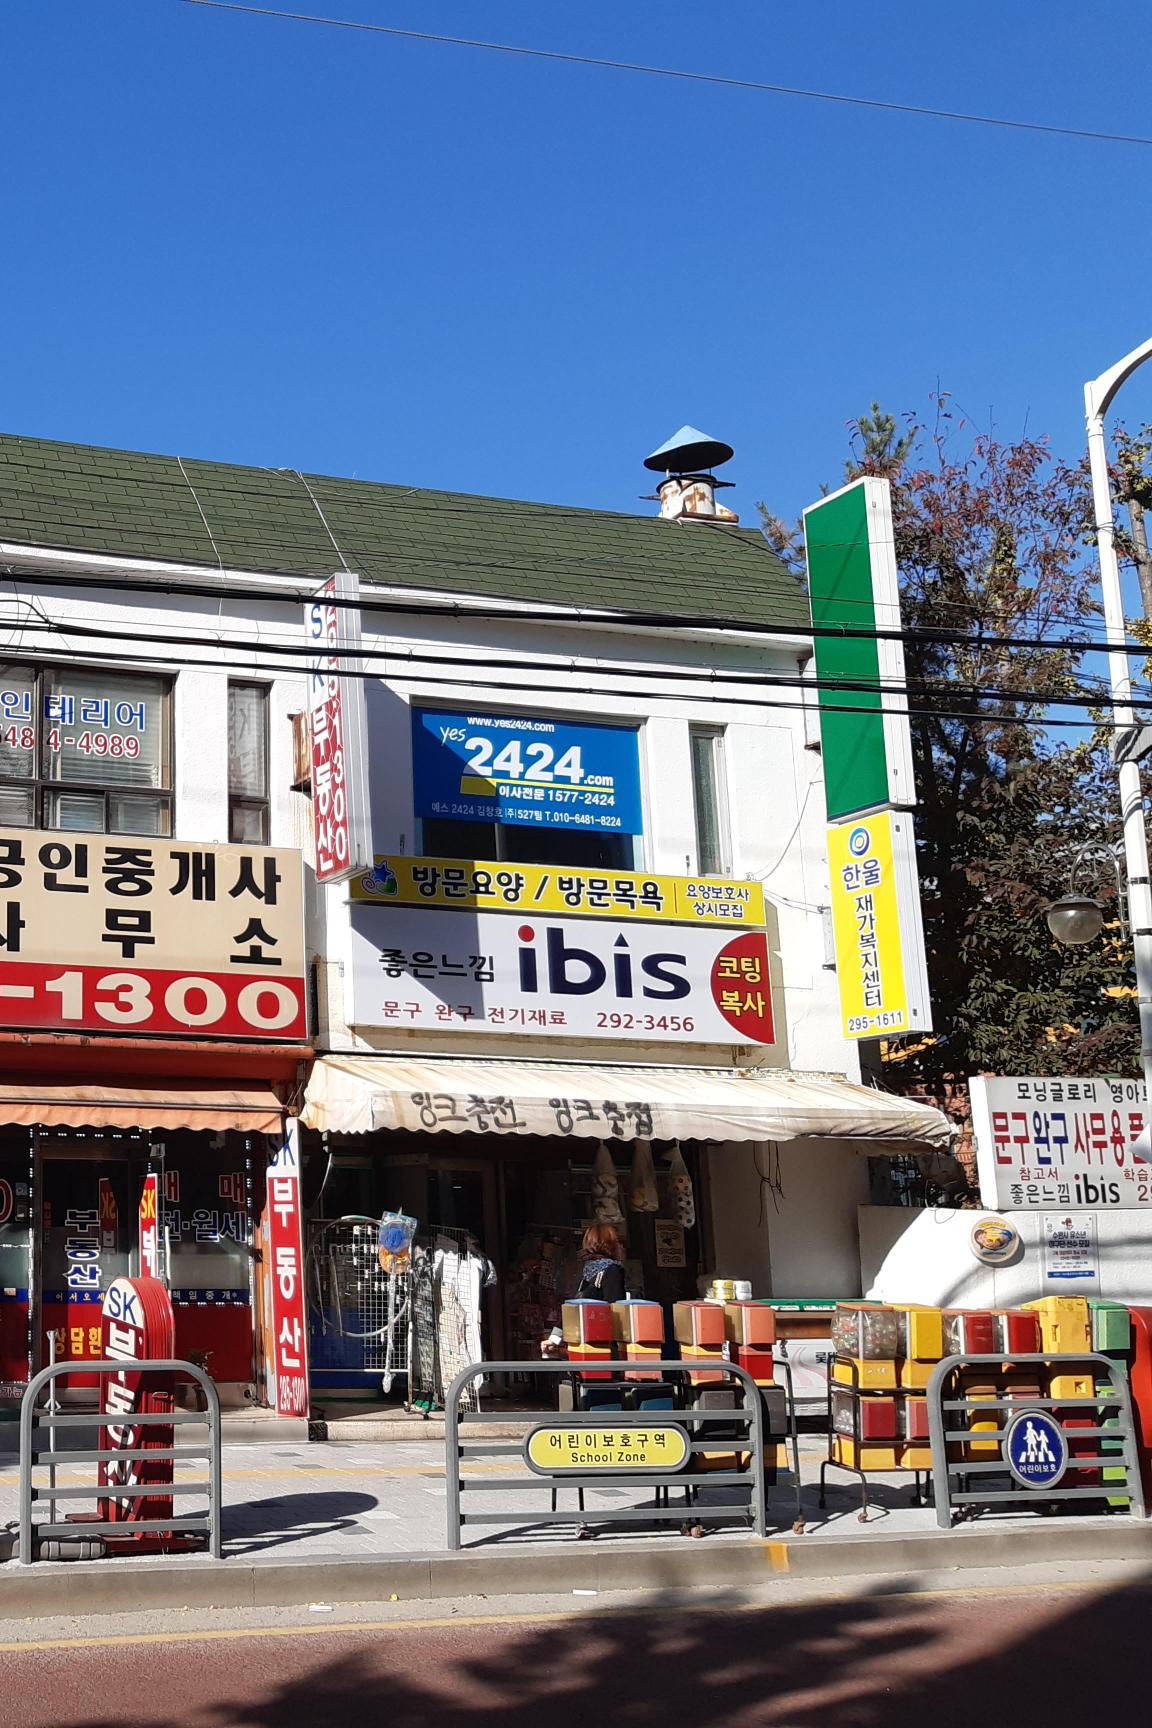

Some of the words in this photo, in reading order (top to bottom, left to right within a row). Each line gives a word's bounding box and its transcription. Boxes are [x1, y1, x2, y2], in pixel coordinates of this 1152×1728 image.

[467, 717, 555, 733] www.yes2424.com
[451, 804, 474, 815] 2424
[499, 786, 545, 801] 이사전문
[547, 790, 615, 807] 1577-2424
[411, 865, 525, 902] 방문요양
[557, 875, 664, 912] 방문목욕
[842, 858, 882, 891] 한울
[685, 883, 750, 902] 요양보호사
[693, 901, 744, 919] 상시모집
[517, 924, 691, 1000] ibis
[855, 893, 882, 1008] 재가복지센터
[378, 948, 495, 983] 좋은느낌
[716, 956, 761, 983] 코팅
[382, 1001, 423, 1019] 문구
[435, 1004, 476, 1022] 완구
[487, 1007, 568, 1027] 전기재료
[596, 1012, 695, 1033] 292-3456
[719, 991, 767, 1018] 복사
[848, 1011, 903, 1031] 295-1611
[1017, 1082, 1097, 1103] 모닝글로리
[269, 1128, 296, 1167] SK
[992, 1112, 1030, 1165] 문구
[1032, 1110, 1069, 1165] 완구
[1010, 1183, 1071, 1205] 좋은느낌
[1074, 1173, 1120, 1204] ibis
[1019, 1167, 1060, 1181] 참고서
[1123, 1168, 1152, 1182] 학습
[141, 1188, 156, 1219] SK
[64, 1209, 102, 1288] 부동산
[273, 1179, 301, 1368] 부동산
[109, 1286, 138, 1325] SK
[549, 1432, 667, 1449] 어린이보호구역
[570, 1450, 613, 1464] School
[617, 1451, 647, 1463] Zone
[1018, 1464, 1057, 1474] 어린이보호
